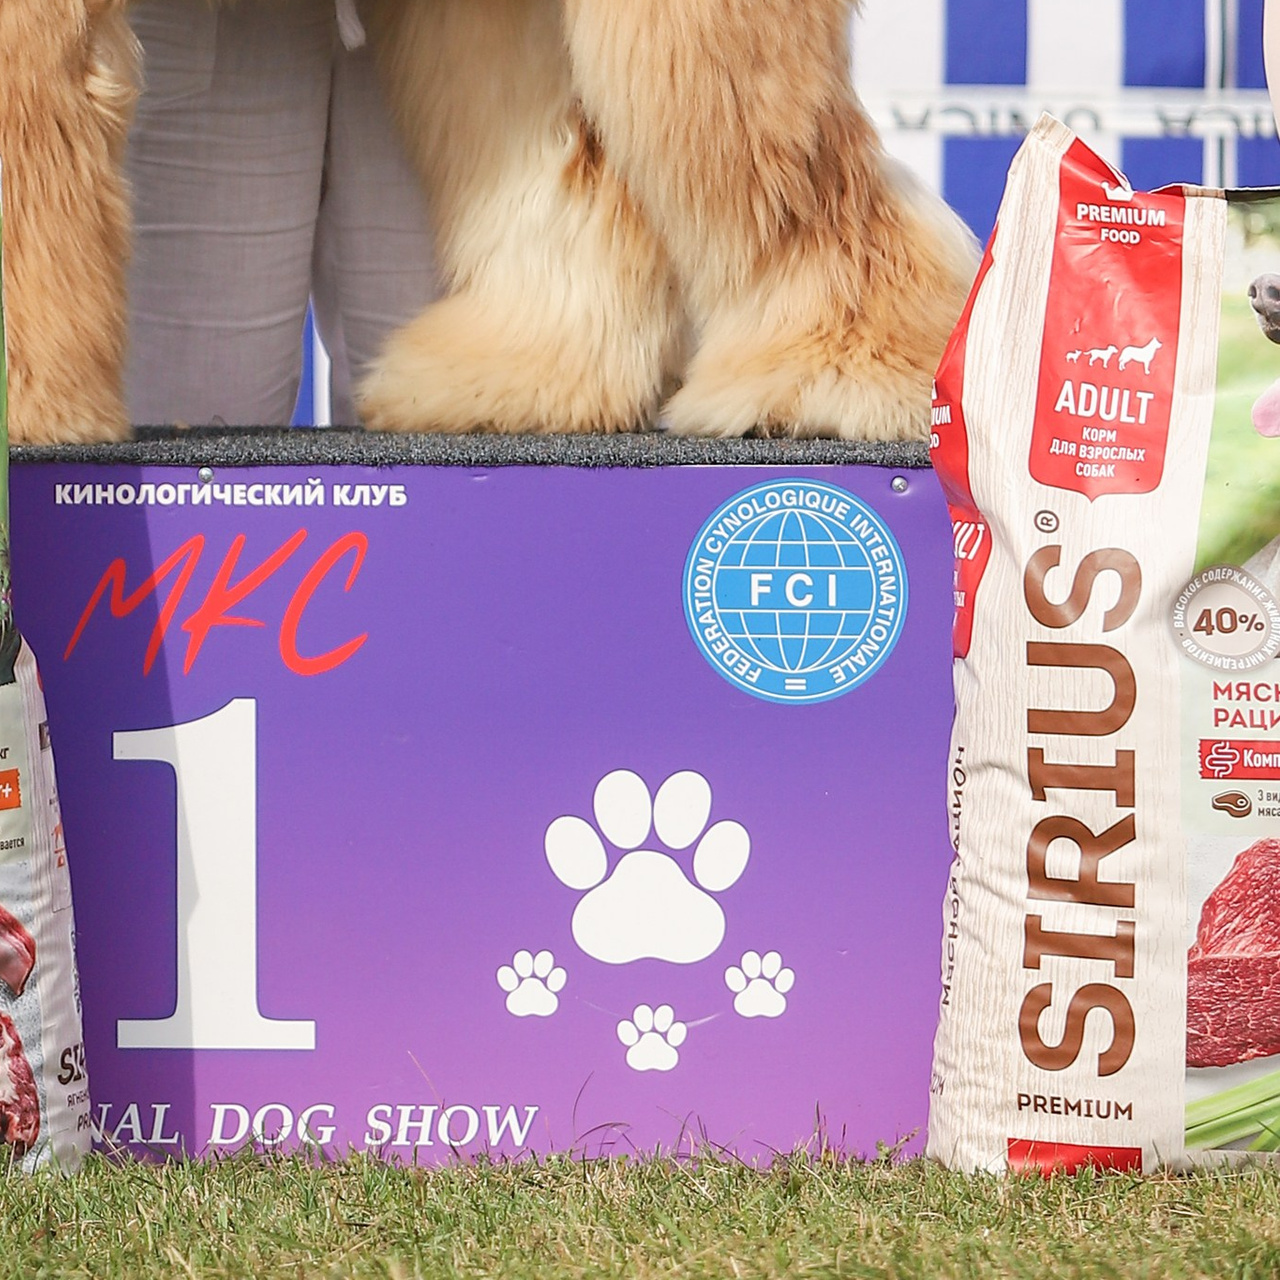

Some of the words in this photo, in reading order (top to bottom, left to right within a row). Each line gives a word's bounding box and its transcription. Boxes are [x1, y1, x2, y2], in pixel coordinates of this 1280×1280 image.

[1076, 203, 1166, 227] PREMIUM
[1099, 228, 1140, 245] FOOD
[1054, 379, 1154, 425] ADULT
[1049, 438, 1077, 457] ДЛЯ
[1079, 443, 1146, 462] ВЗРОСЛЫХ
[1082, 426, 1117, 444] КОРМ
[1075, 461, 1115, 478] СОБАК
[54, 477, 325, 506] КИНОЛОГИЧЕСКИЙ
[333, 484, 408, 507] КЛУБ
[705, 489, 851, 554] CYNOLOGIQUE
[750, 572, 837, 607] FCI
[828, 513, 897, 684] INTERNATIONALE
[1201, 568, 1267, 601] СОДЕРЖАНИЕ
[63, 527, 369, 676] МКС
[1173, 578, 1202, 628] ВЫСОКОЕ
[694, 558, 763, 684] FEDERATION
[1193, 607, 1265, 636] 40%
[1182, 639, 1266, 670] ИНГРЕДИЕНТОВ
[1214, 708, 1280, 731] РАЦИ
[1243, 749, 1280, 768] Комп
[1018, 544, 1143, 1077] SIRIUS
[1258, 789, 1264, 801] 3
[112, 697, 316, 1050] 1
[1017, 1092, 1133, 1121] PREMIUM
[90, 1103, 180, 1144] NAL
[207, 1103, 337, 1146] DOG
[364, 1104, 539, 1147] SHOW
